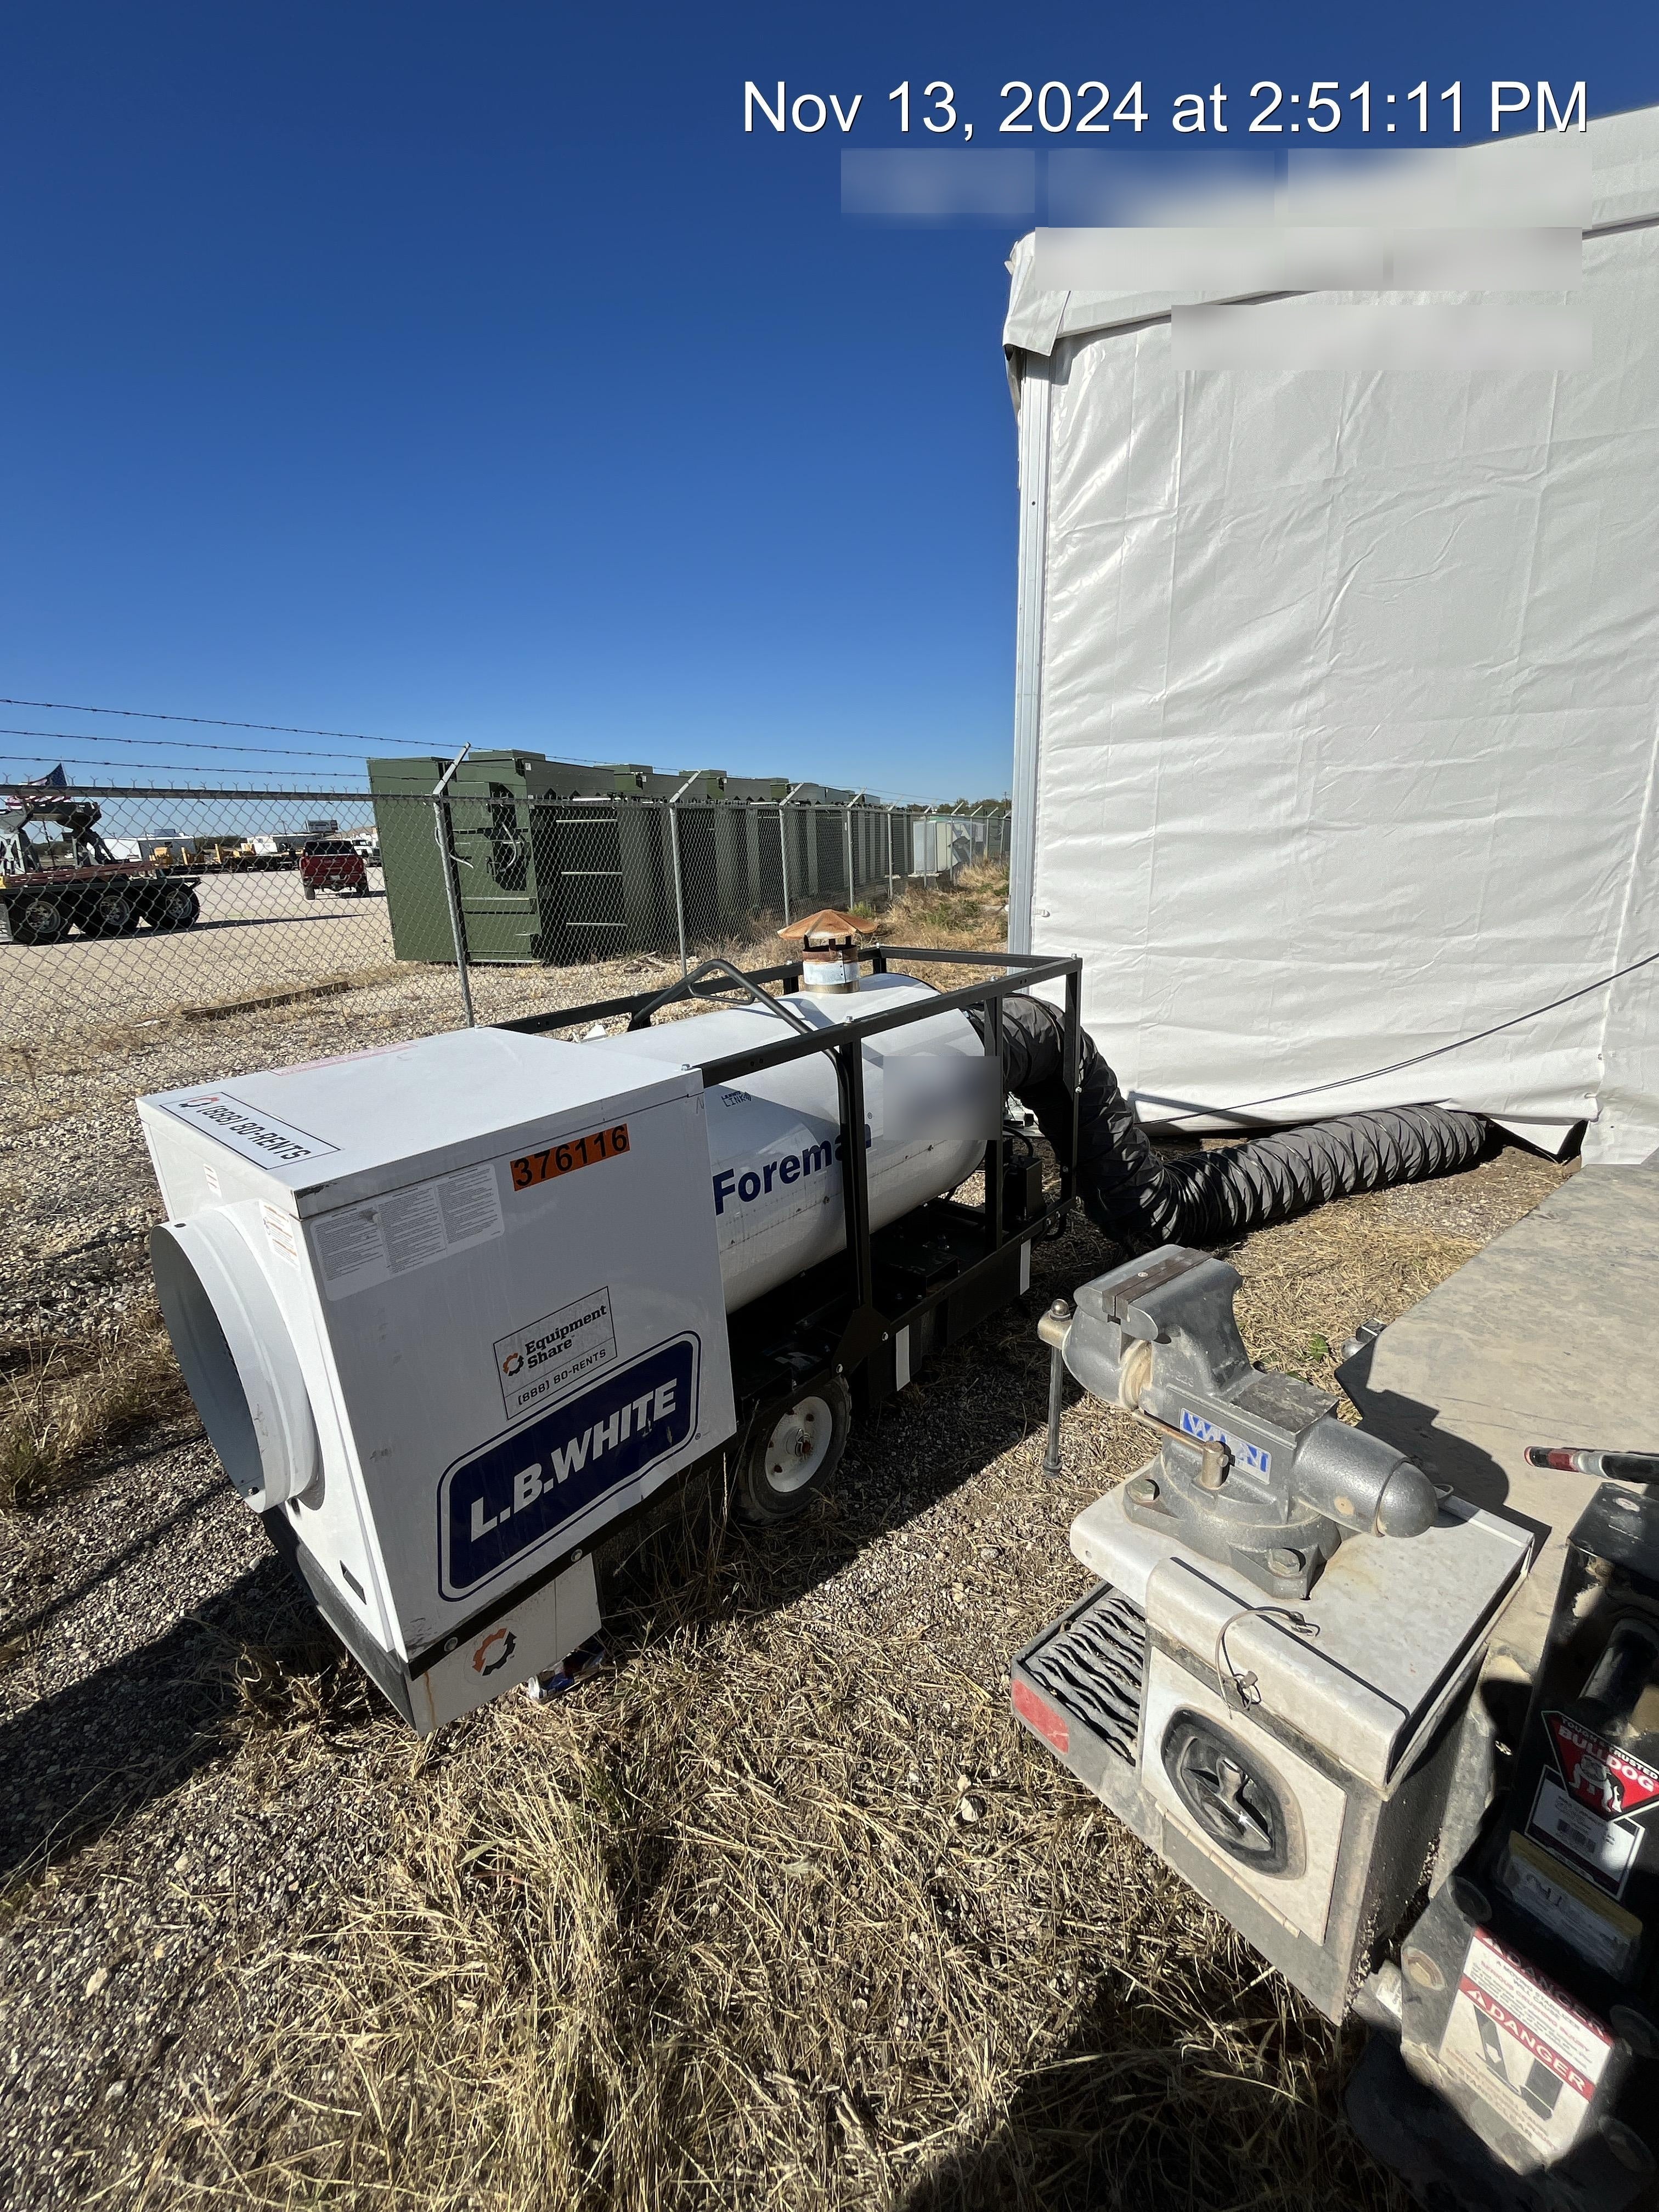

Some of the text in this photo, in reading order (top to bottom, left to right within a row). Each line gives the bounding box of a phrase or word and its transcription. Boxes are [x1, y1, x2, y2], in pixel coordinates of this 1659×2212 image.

[723, 1094, 746, 1107] LINK
[196, 1105, 312, 1160] (888) 80-RENTS
[514, 1125, 627, 1187] 376116
[712, 1124, 872, 1216] Forem
[524, 1305, 607, 1356] Equipment
[527, 1339, 573, 1369] Share
[518, 1348, 606, 1406] (888) 80-RENTS
[1558, 1724, 1655, 1793] BULLDOG
[1609, 1746, 1659, 1780] TRUSTED
[1506, 1950, 1605, 2038] DANGER
[1487, 2006, 1585, 2092] DANGER
